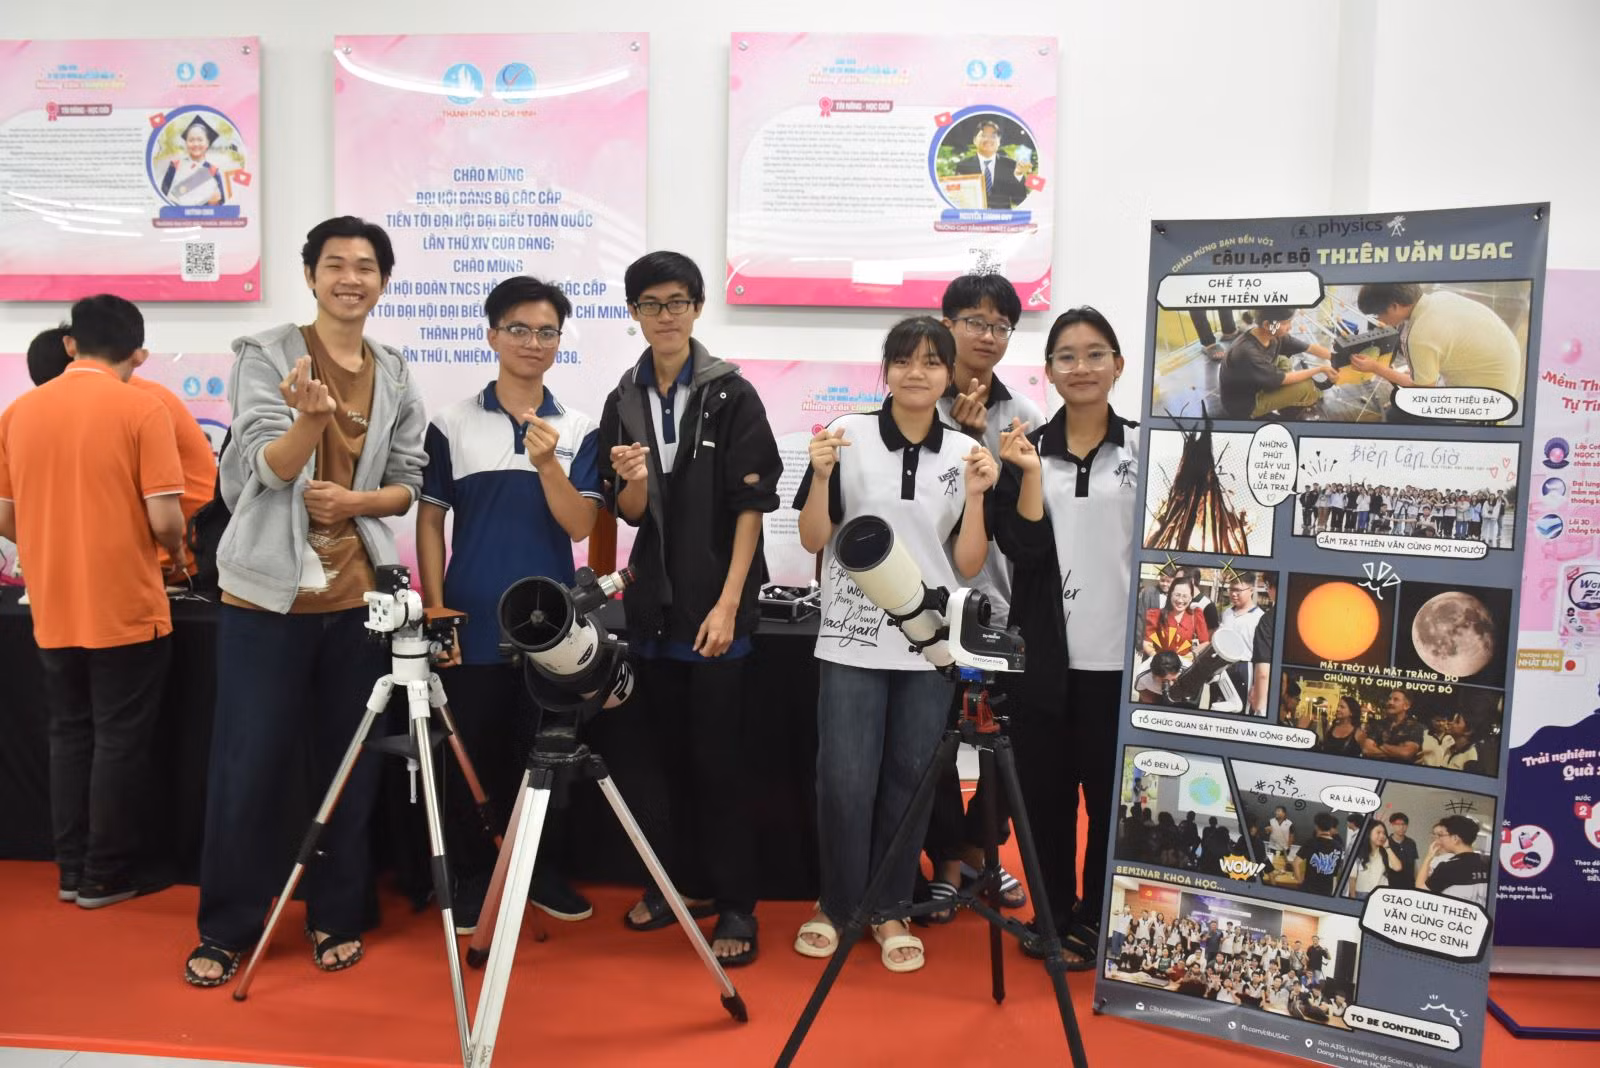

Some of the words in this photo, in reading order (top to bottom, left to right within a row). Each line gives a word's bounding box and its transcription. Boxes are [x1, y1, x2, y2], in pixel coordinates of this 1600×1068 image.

[453, 166, 485, 182] CHÀO
[1318, 218, 1383, 237] physics
[472, 236, 490, 250] XIV
[1212, 249, 1245, 266] CÂU
[1250, 252, 1283, 269] LẠC
[1287, 247, 1311, 268] BỘ
[1317, 241, 1389, 265] THIÊN
[1395, 240, 1443, 263] VĂN
[1450, 241, 1513, 261] USAC
[453, 257, 485, 273] CHÀO
[1171, 255, 1193, 273] CHÀO
[450, 282, 480, 296] TNCS
[1238, 278, 1262, 290] TẠO
[1185, 292, 1216, 304] KÍNH
[1220, 291, 1259, 304] THIÊN
[1263, 290, 1288, 303] VĂN
[397, 304, 416, 320] ĐẠI
[440, 304, 459, 320] ĐẠI
[598, 305, 631, 319] MINH
[1412, 395, 1428, 404] XIN
[1434, 406, 1456, 415] KÍNH
[1458, 407, 1482, 416] USAC
[1484, 408, 1491, 416] T
[1276, 463, 1290, 471] VUI
[1360, 537, 1385, 548] THIÊN
[1320, 660, 1338, 671] MẶT
[1368, 665, 1380, 675] VÀ
[1383, 666, 1402, 678] MẶT
[1405, 669, 1438, 681] TRĂNG
[1323, 672, 1357, 684] CHÚNG
[1376, 678, 1403, 690] CHỤP
[1406, 682, 1436, 693] ĐƯỢC
[1438, 683, 1453, 694] ĐÓ
[1175, 720, 1197, 730] QUAN
[1215, 725, 1239, 735] THIÊN
[1241, 728, 1258, 738] VĂN
[1154, 761, 1169, 769] ĐEN
[1521, 752, 1550, 767] Trải
[1551, 748, 1597, 763] nghiệm
[1562, 763, 1595, 781] Quà
[1330, 793, 1341, 801] RA
[1579, 805, 1588, 816] 2
[1116, 865, 1161, 880] SEMINAR
[1163, 872, 1191, 885] KHOA
[1219, 857, 1267, 877] WOW!
[1382, 894, 1412, 907] GIAO
[1416, 900, 1438, 912] LƯU
[1443, 904, 1477, 921] THIÊN
[1384, 908, 1407, 920] VĂN
[1411, 913, 1444, 928] CÙNG
[1447, 921, 1472, 935] CÁC
[1384, 923, 1407, 936] BẠN
[1411, 928, 1437, 942] HỌC
[1440, 934, 1469, 950] SINH
[1351, 1013, 1364, 1023] TO
[1367, 1017, 1379, 1027] BE
[1382, 1021, 1450, 1044] CONTINUED...
[1347, 1046, 1379, 1060] University
[1379, 1054, 1388, 1062] of
